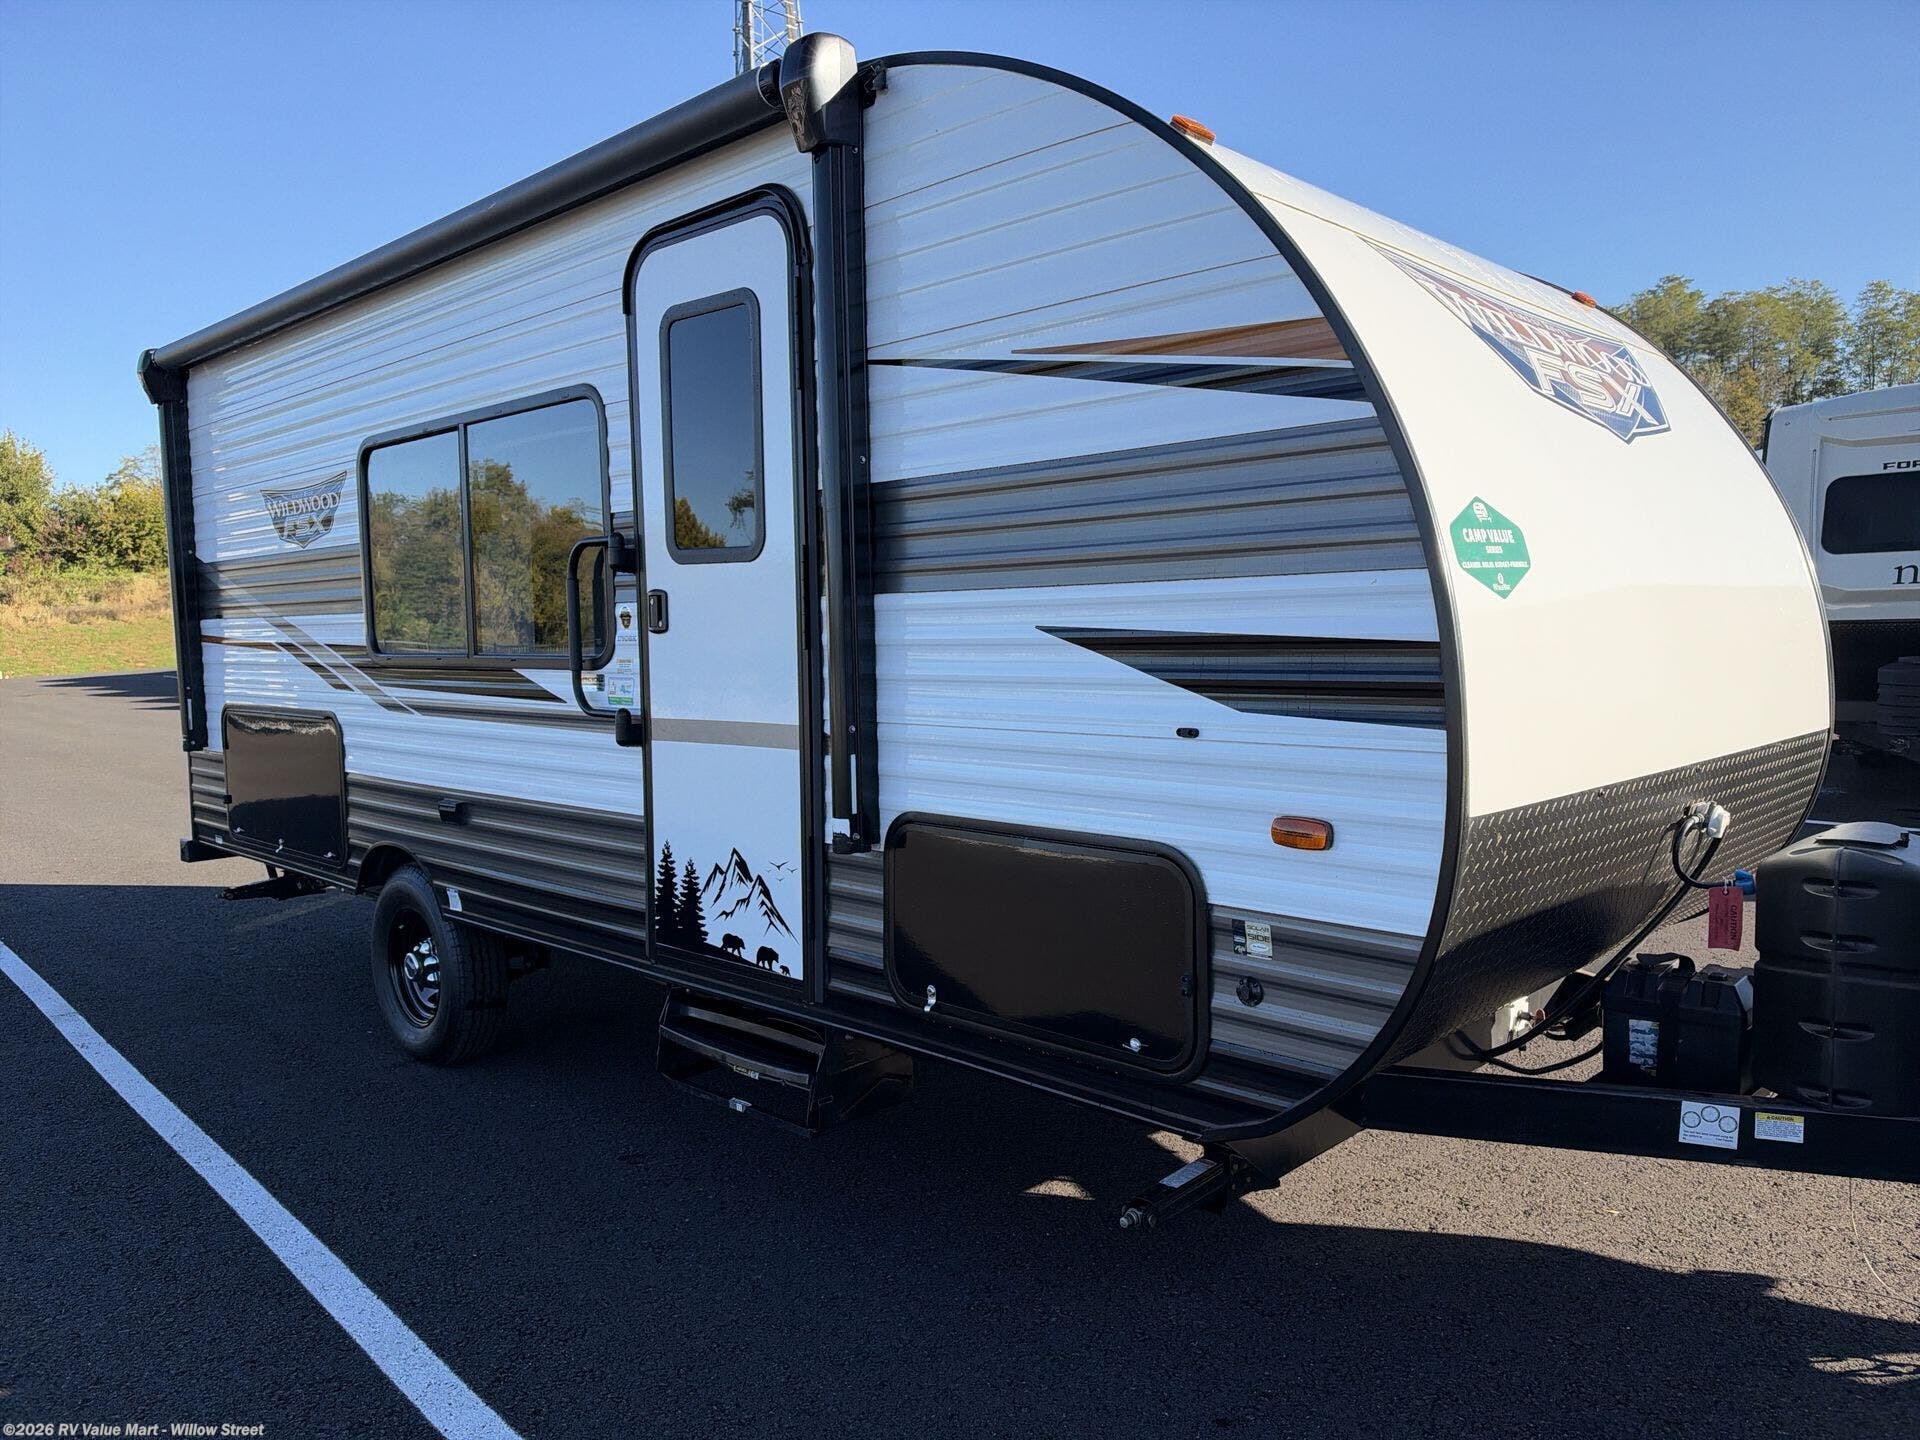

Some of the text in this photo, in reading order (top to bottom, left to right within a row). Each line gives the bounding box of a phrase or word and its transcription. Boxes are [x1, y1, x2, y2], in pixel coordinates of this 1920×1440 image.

[1522, 345, 1659, 425] FSX
[268, 492, 340, 518] WILDWOOD
[1462, 528, 1515, 543] CAMP VALUE
